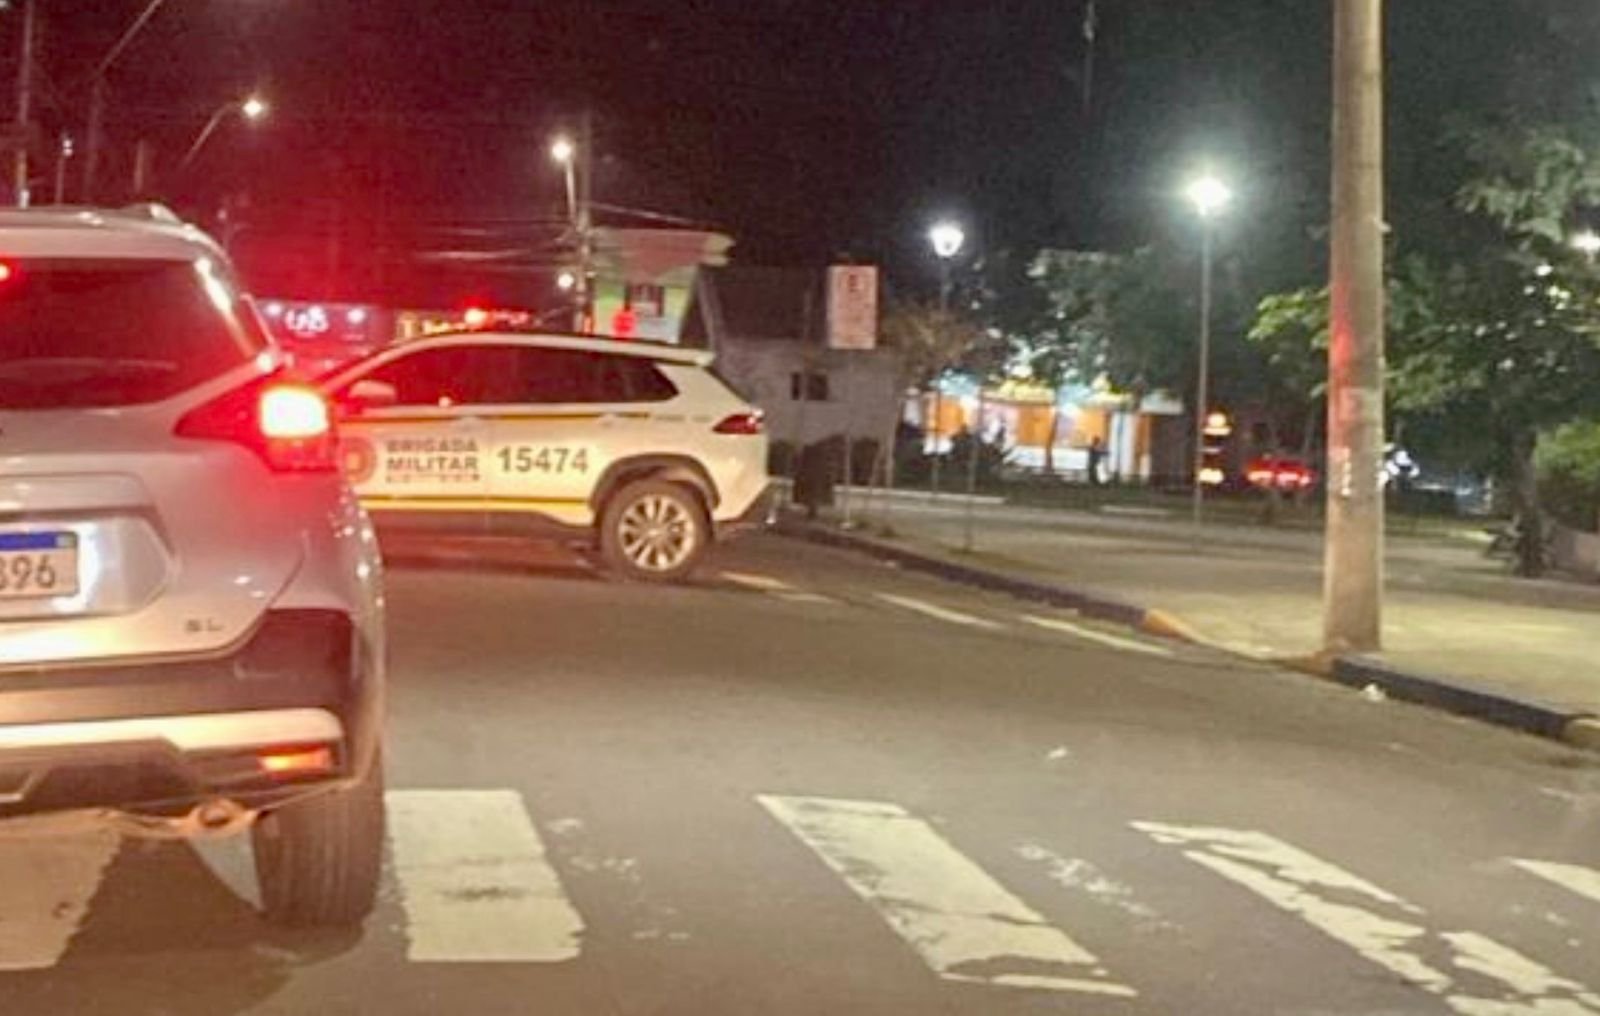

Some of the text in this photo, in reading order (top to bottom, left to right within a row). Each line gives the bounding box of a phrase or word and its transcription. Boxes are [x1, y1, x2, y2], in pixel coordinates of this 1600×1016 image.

[385, 438, 479, 452] BRIGADA
[385, 455, 479, 471] MILITAR
[497, 446, 589, 474] 15474
